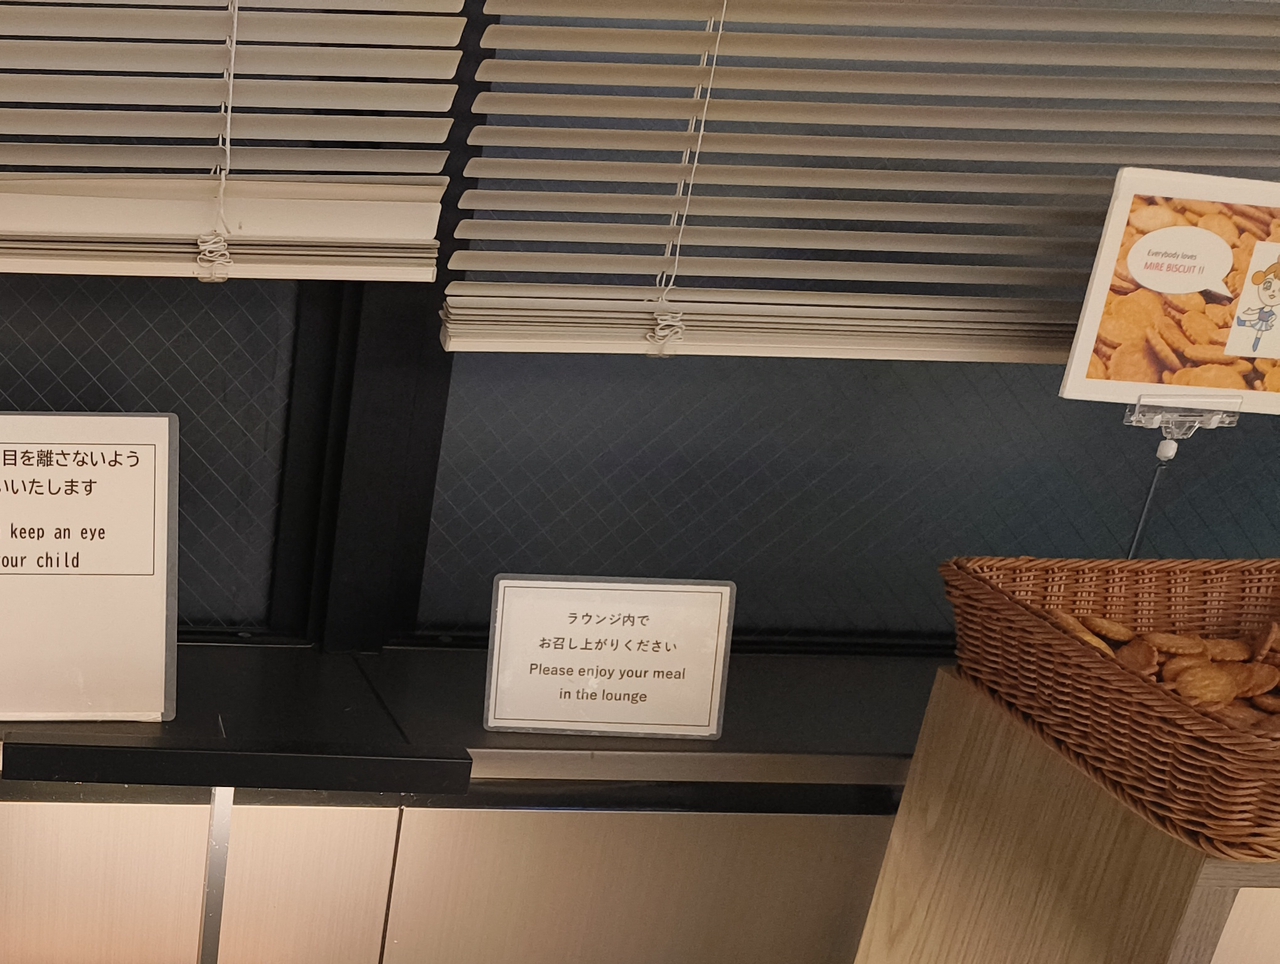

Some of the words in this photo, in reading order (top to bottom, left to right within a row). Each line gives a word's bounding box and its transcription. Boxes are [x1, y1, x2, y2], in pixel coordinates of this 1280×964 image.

[1181, 252, 1197, 260] loves
[1166, 263, 1196, 274] BISCUIT
[10, 523, 45, 541] keep
[54, 527, 71, 540] an
[80, 528, 106, 541] eye
[36, 552, 80, 568] child
[568, 612, 650, 627] ラウンジ内で
[538, 637, 677, 652] お召し上がりください
[529, 664, 574, 676] Please
[578, 666, 615, 680] enjoy
[618, 668, 649, 680] your
[653, 668, 686, 680] meal
[559, 688, 571, 699] in
[576, 689, 597, 700] the
[602, 689, 647, 704] lounge
